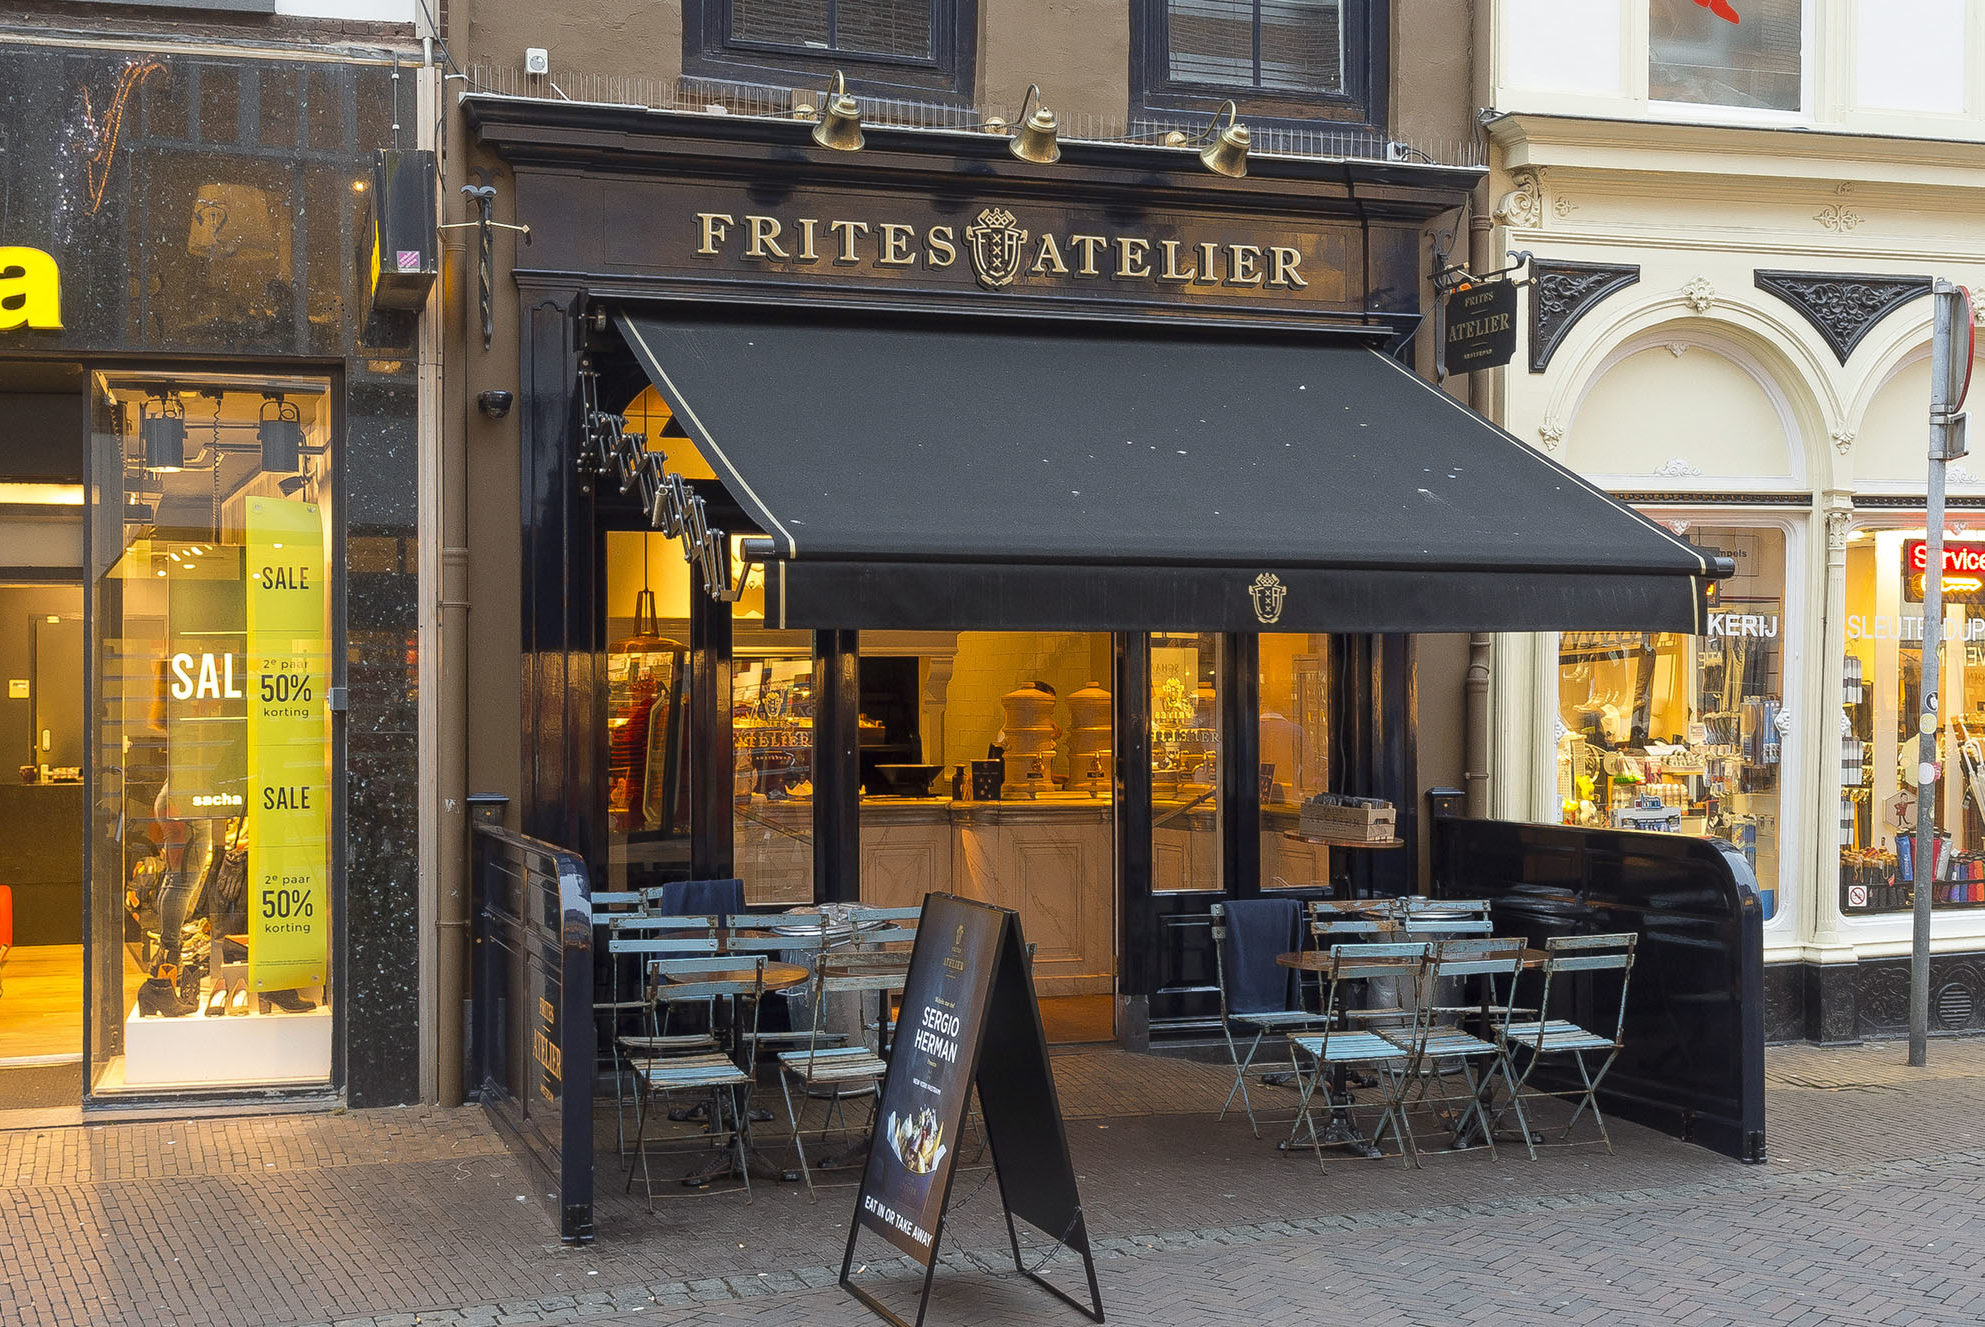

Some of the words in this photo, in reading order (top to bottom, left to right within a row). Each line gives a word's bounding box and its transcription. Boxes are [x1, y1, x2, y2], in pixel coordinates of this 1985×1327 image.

[696, 212, 957, 268] FRITES
[1032, 232, 1309, 287] ATELIER
[1464, 290, 1495, 308] FRITES
[1448, 312, 1510, 343] ATELIER
[1913, 544, 1985, 570] Srvice
[262, 566, 310, 590] SALE
[171, 652, 243, 701] SAL
[280, 660, 309, 671] paar
[261, 674, 312, 703] 50%
[263, 707, 310, 719] korting
[192, 792, 243, 807] sacha
[263, 786, 310, 810] SALE
[282, 875, 310, 887] paar
[262, 889, 313, 919] 50%
[264, 922, 311, 934] korting
[922, 1006, 960, 1038] SERGIO
[533, 1027, 562, 1082] ATELIER
[914, 1028, 958, 1064] HERMAN
[864, 1195, 878, 1213] EAT
[876, 1203, 886, 1219] IN
[885, 1208, 896, 1225] OR
[895, 1213, 913, 1236] TAKE
[911, 1225, 933, 1248] AWAY
